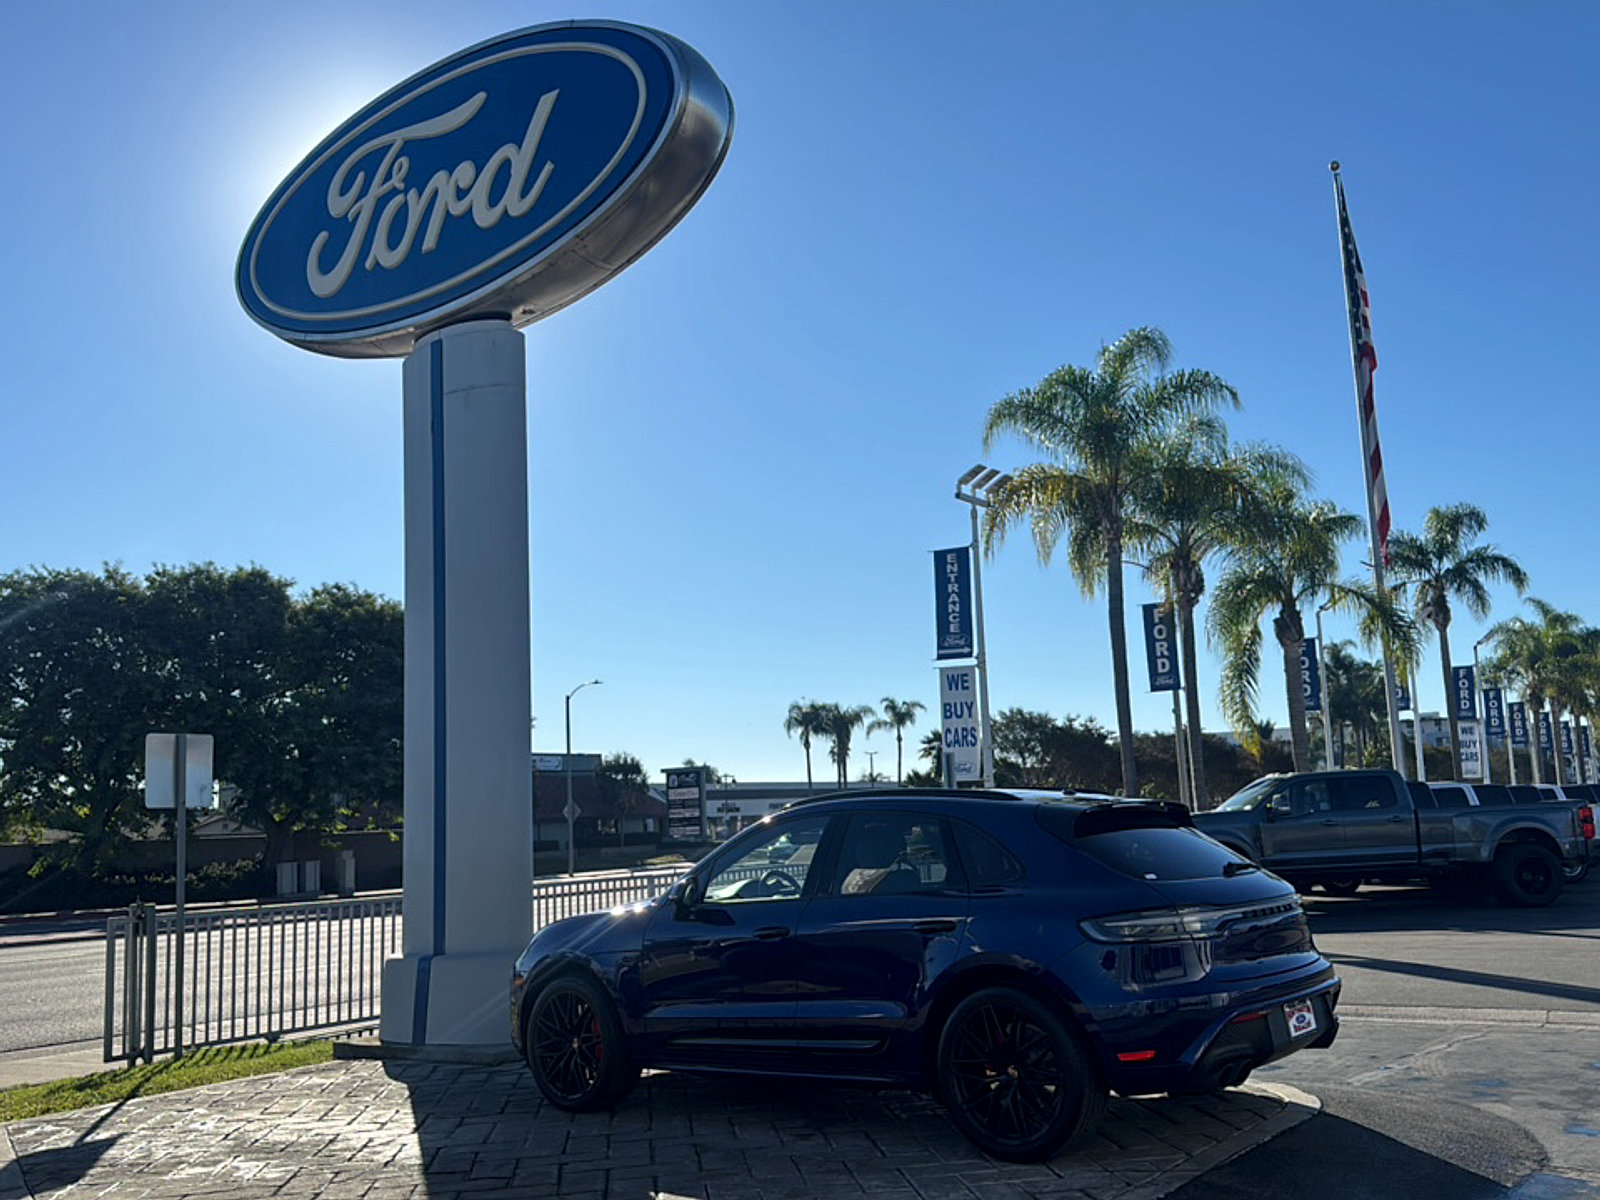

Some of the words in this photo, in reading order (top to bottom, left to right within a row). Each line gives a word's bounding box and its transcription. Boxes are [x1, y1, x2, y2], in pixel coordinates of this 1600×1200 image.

[307, 88, 560, 298] Ford
[946, 553, 961, 633] ENTRANCE
[1153, 608, 1170, 673] FORD
[946, 673, 970, 691] WE
[1458, 668, 1470, 710] FORD
[943, 701, 974, 719] BUY
[1488, 690, 1500, 727] FORD
[1512, 704, 1523, 736] FORD
[944, 727, 978, 748] CARS
